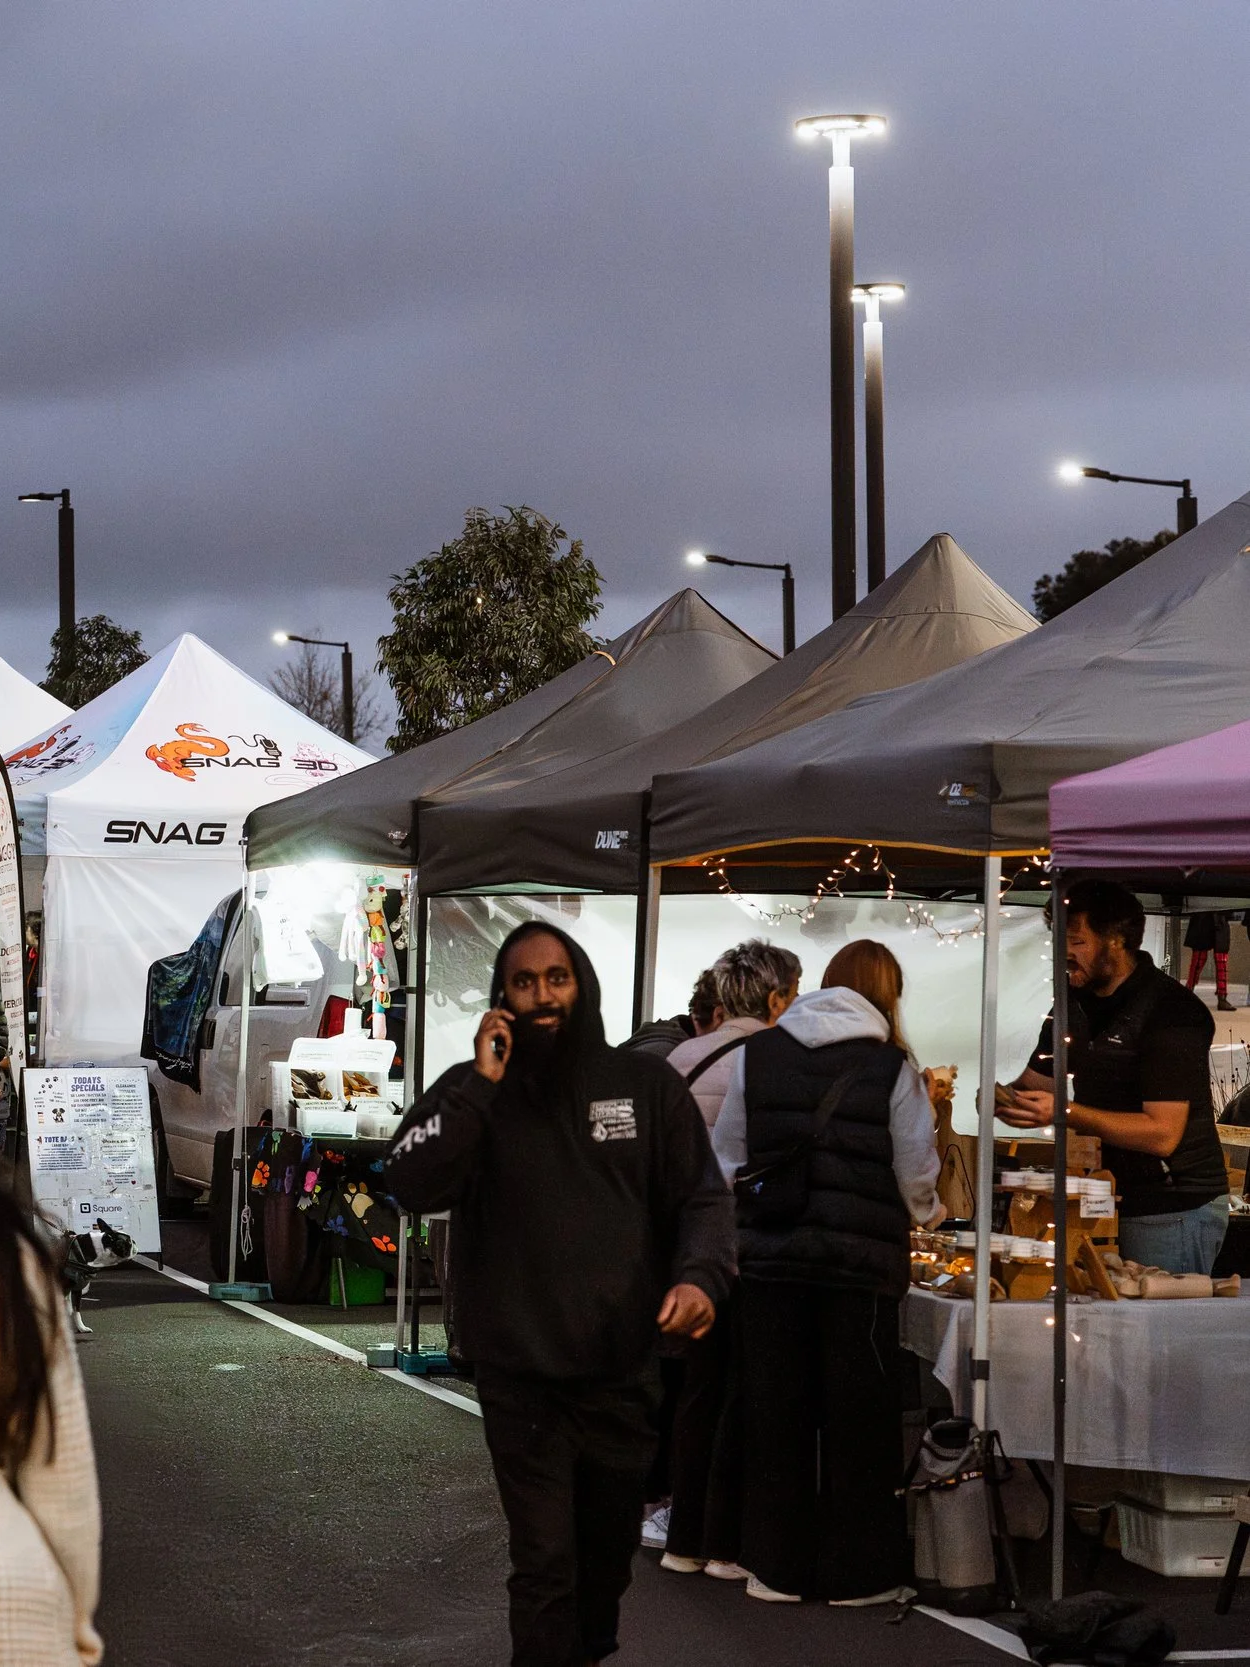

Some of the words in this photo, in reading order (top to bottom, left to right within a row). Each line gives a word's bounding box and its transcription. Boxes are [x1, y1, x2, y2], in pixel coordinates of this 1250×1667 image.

[179, 757, 281, 768] SNAG
[293, 759, 338, 772] 3D
[103, 820, 227, 845] SNAG
[595, 831, 620, 849] DUNE
[73, 1077, 101, 1085] TODAYS
[71, 1084, 105, 1092] SPECIALS
[92, 1204, 123, 1214] Square
